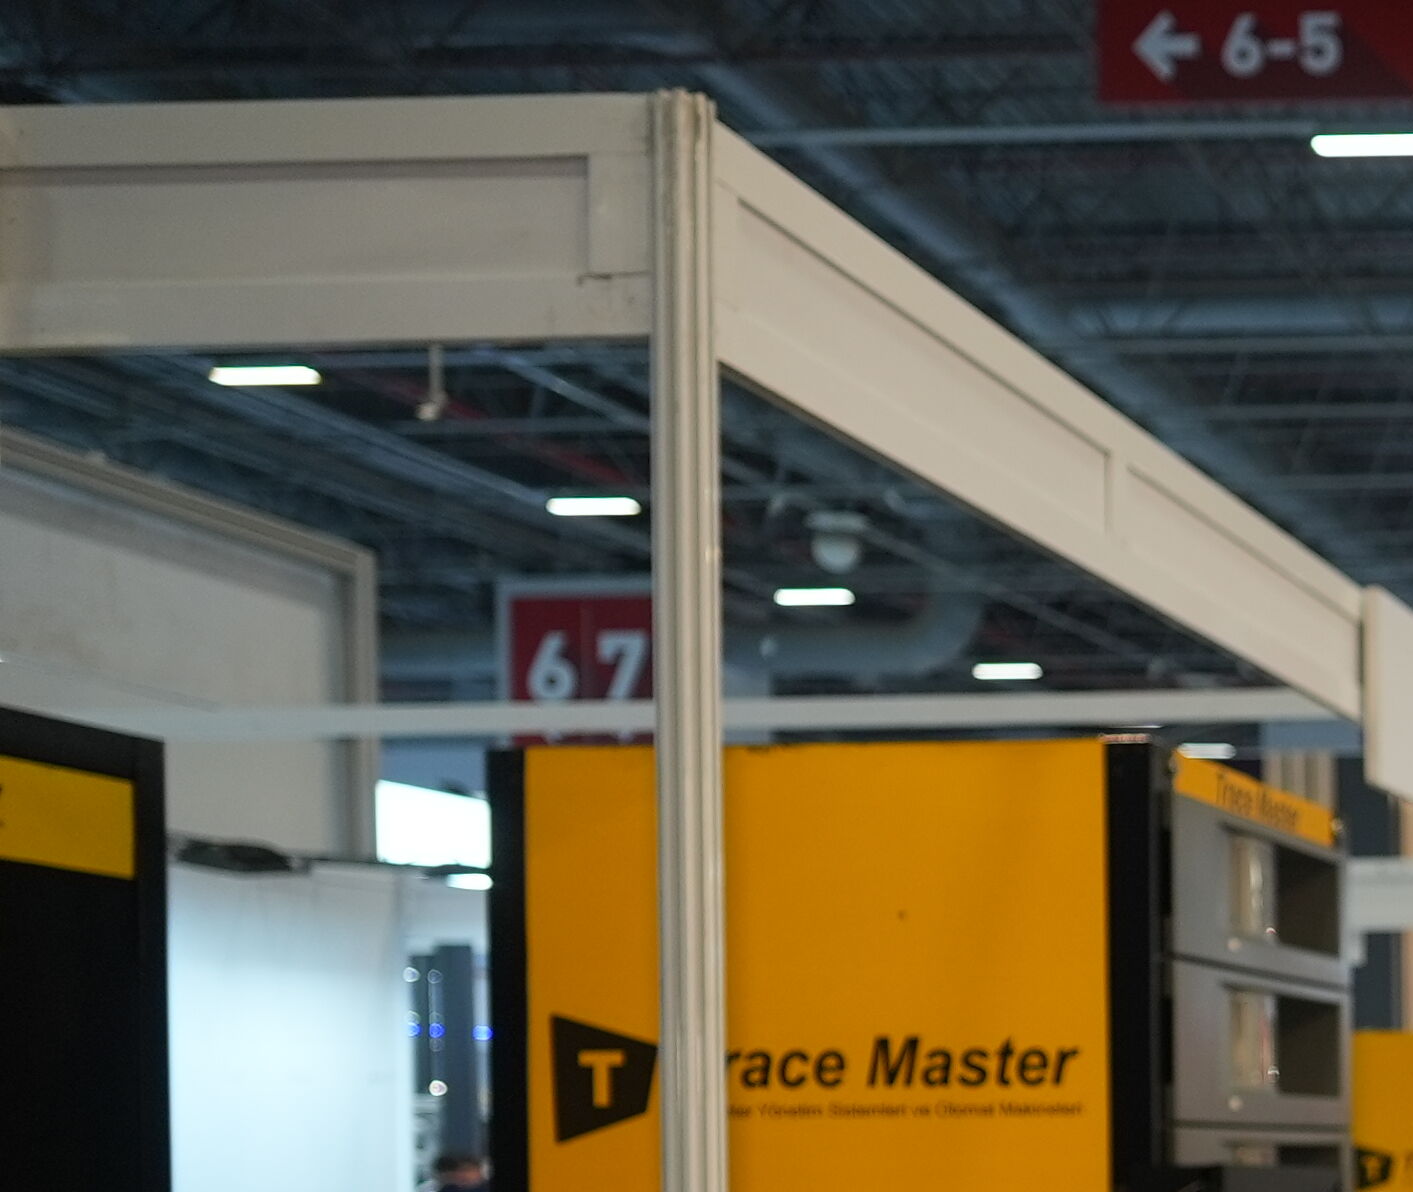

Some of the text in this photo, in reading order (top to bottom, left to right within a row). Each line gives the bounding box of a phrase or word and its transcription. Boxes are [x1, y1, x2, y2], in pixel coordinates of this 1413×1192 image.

[1220, 10, 1342, 78] 6-5
[526, 629, 648, 706] 6 7
[724, 1034, 1080, 1090] race Master
